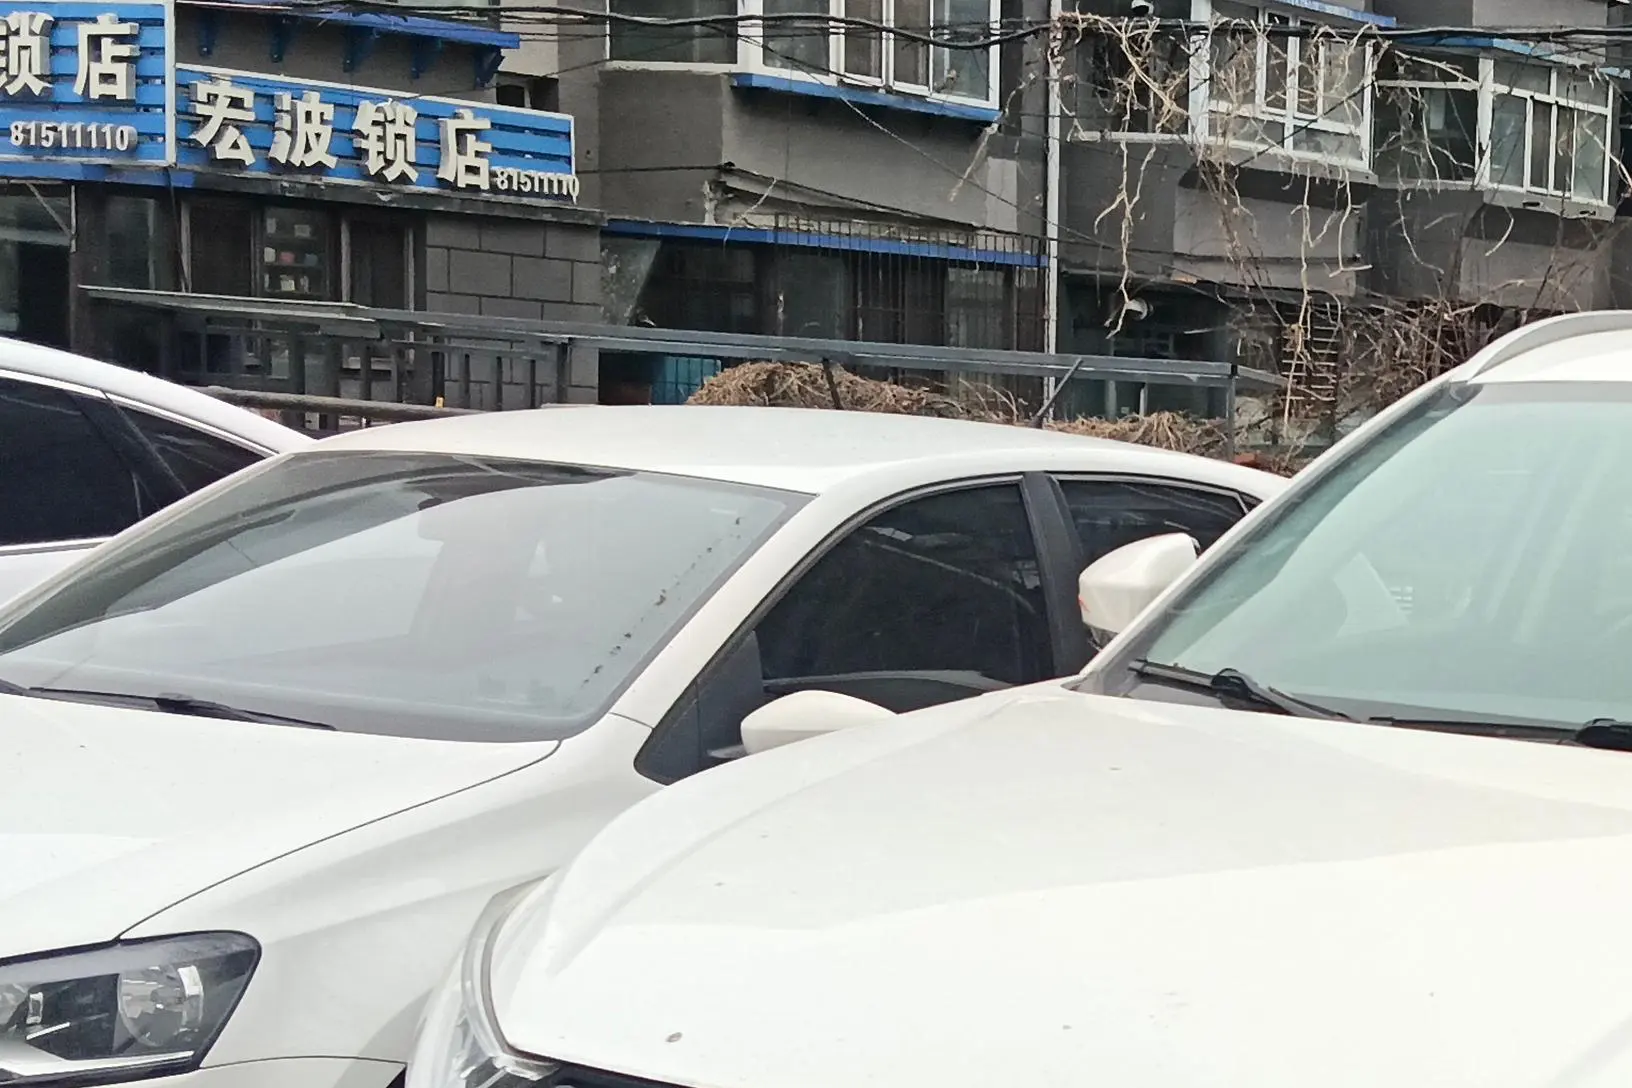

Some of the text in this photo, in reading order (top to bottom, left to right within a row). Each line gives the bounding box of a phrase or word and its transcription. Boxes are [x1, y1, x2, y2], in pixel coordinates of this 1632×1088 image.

[10, 120, 137, 151] 81511110
[189, 79, 492, 190] 宏波锁店
[494, 166, 580, 197] 81511110
